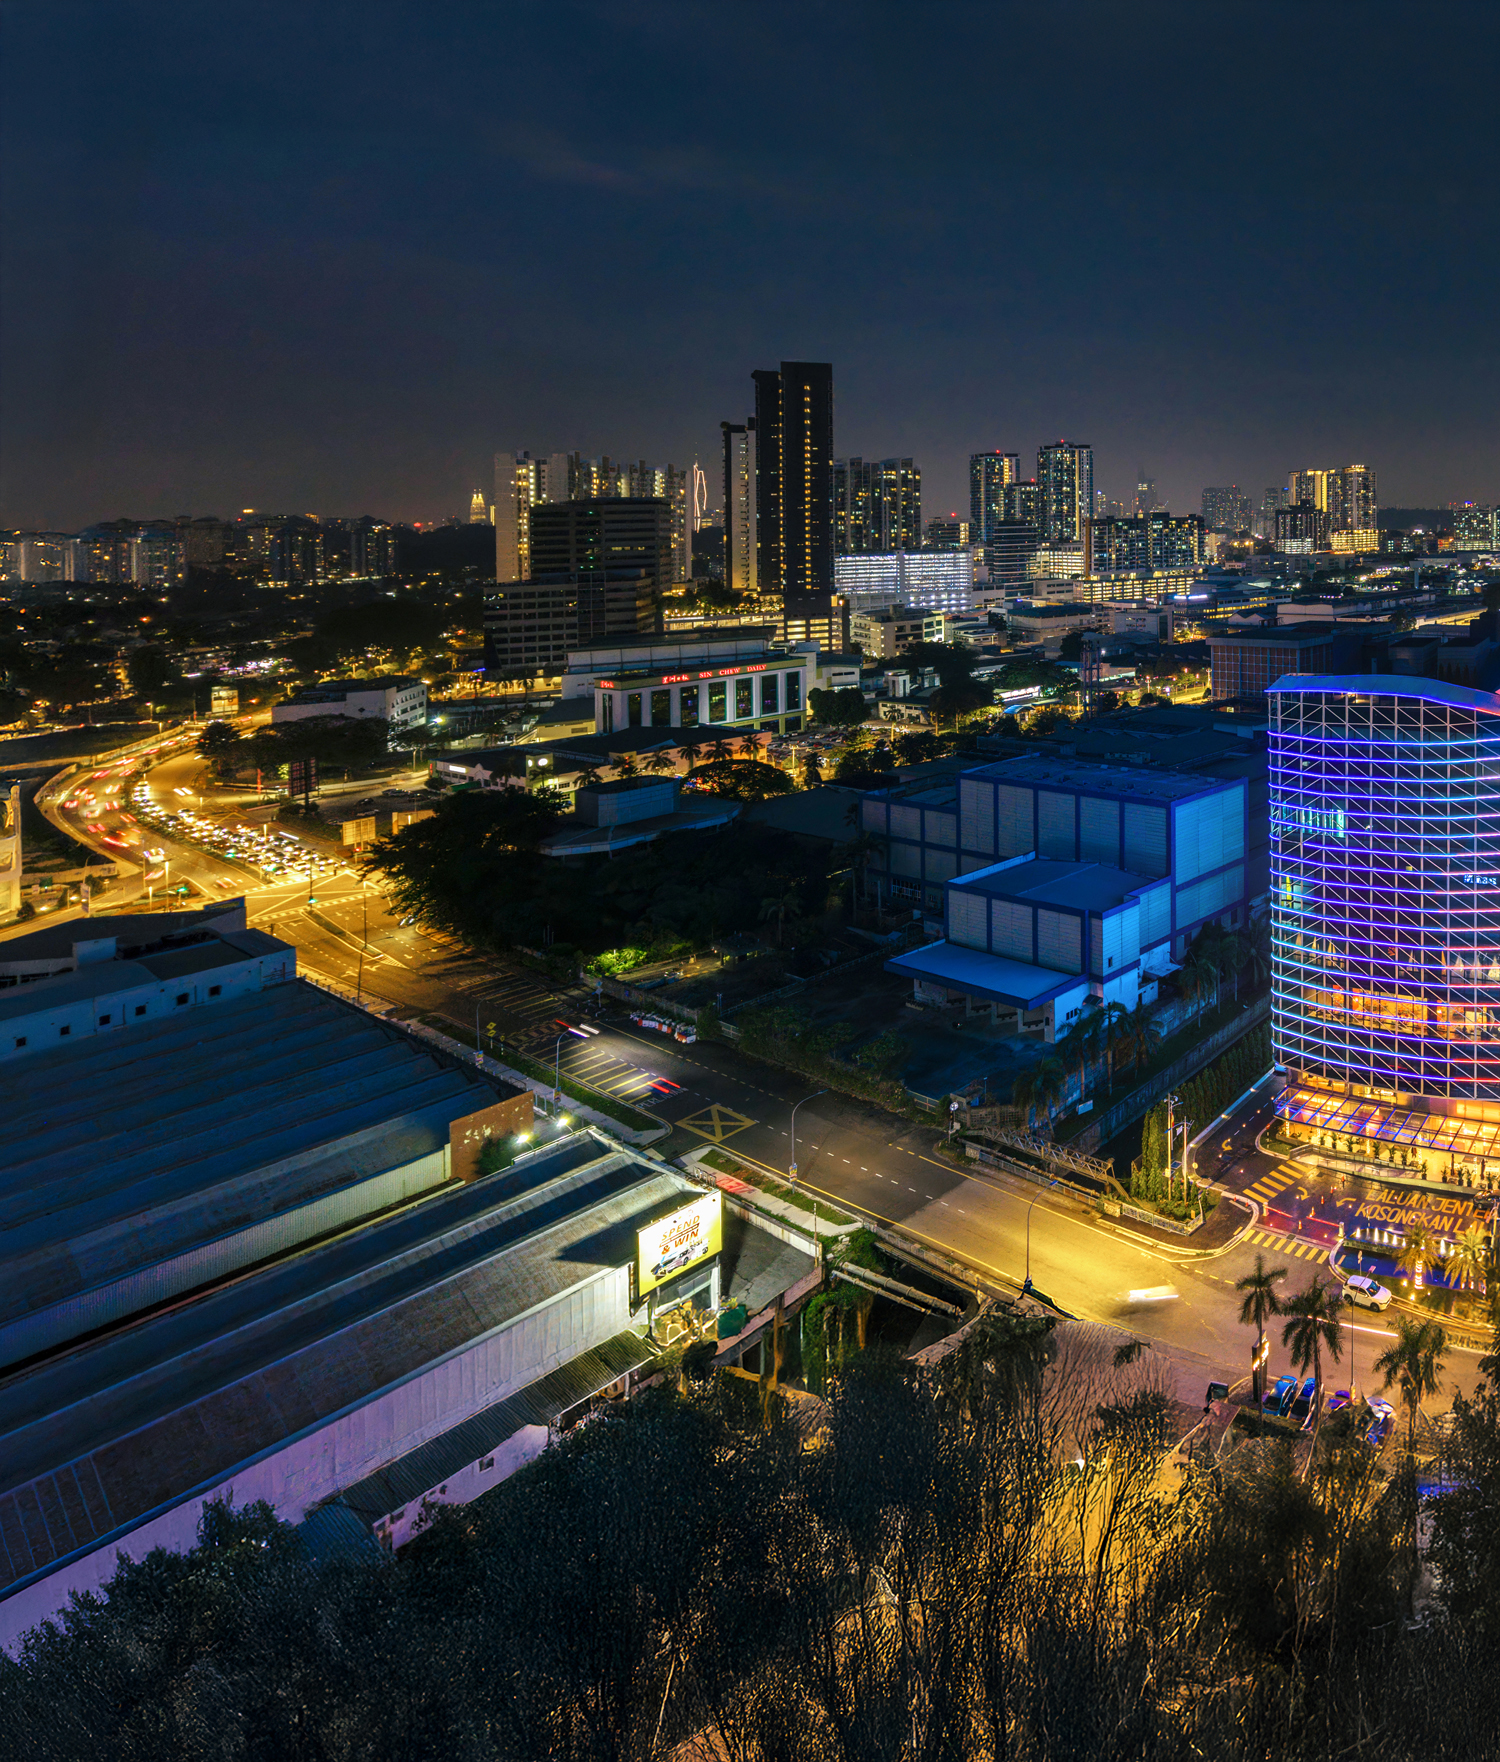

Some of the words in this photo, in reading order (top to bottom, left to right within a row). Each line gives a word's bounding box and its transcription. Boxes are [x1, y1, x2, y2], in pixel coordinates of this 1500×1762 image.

[699, 671, 712, 679] SIN
[719, 667, 740, 676] CHEW
[747, 664, 767, 672] DAILY
[1365, 1188, 1431, 1209] LALUAN
[662, 1215, 700, 1239] SPEND
[1355, 1202, 1454, 1232] KOSONGKAN
[662, 1245, 670, 1255] &
[675, 1229, 699, 1248] WIN
